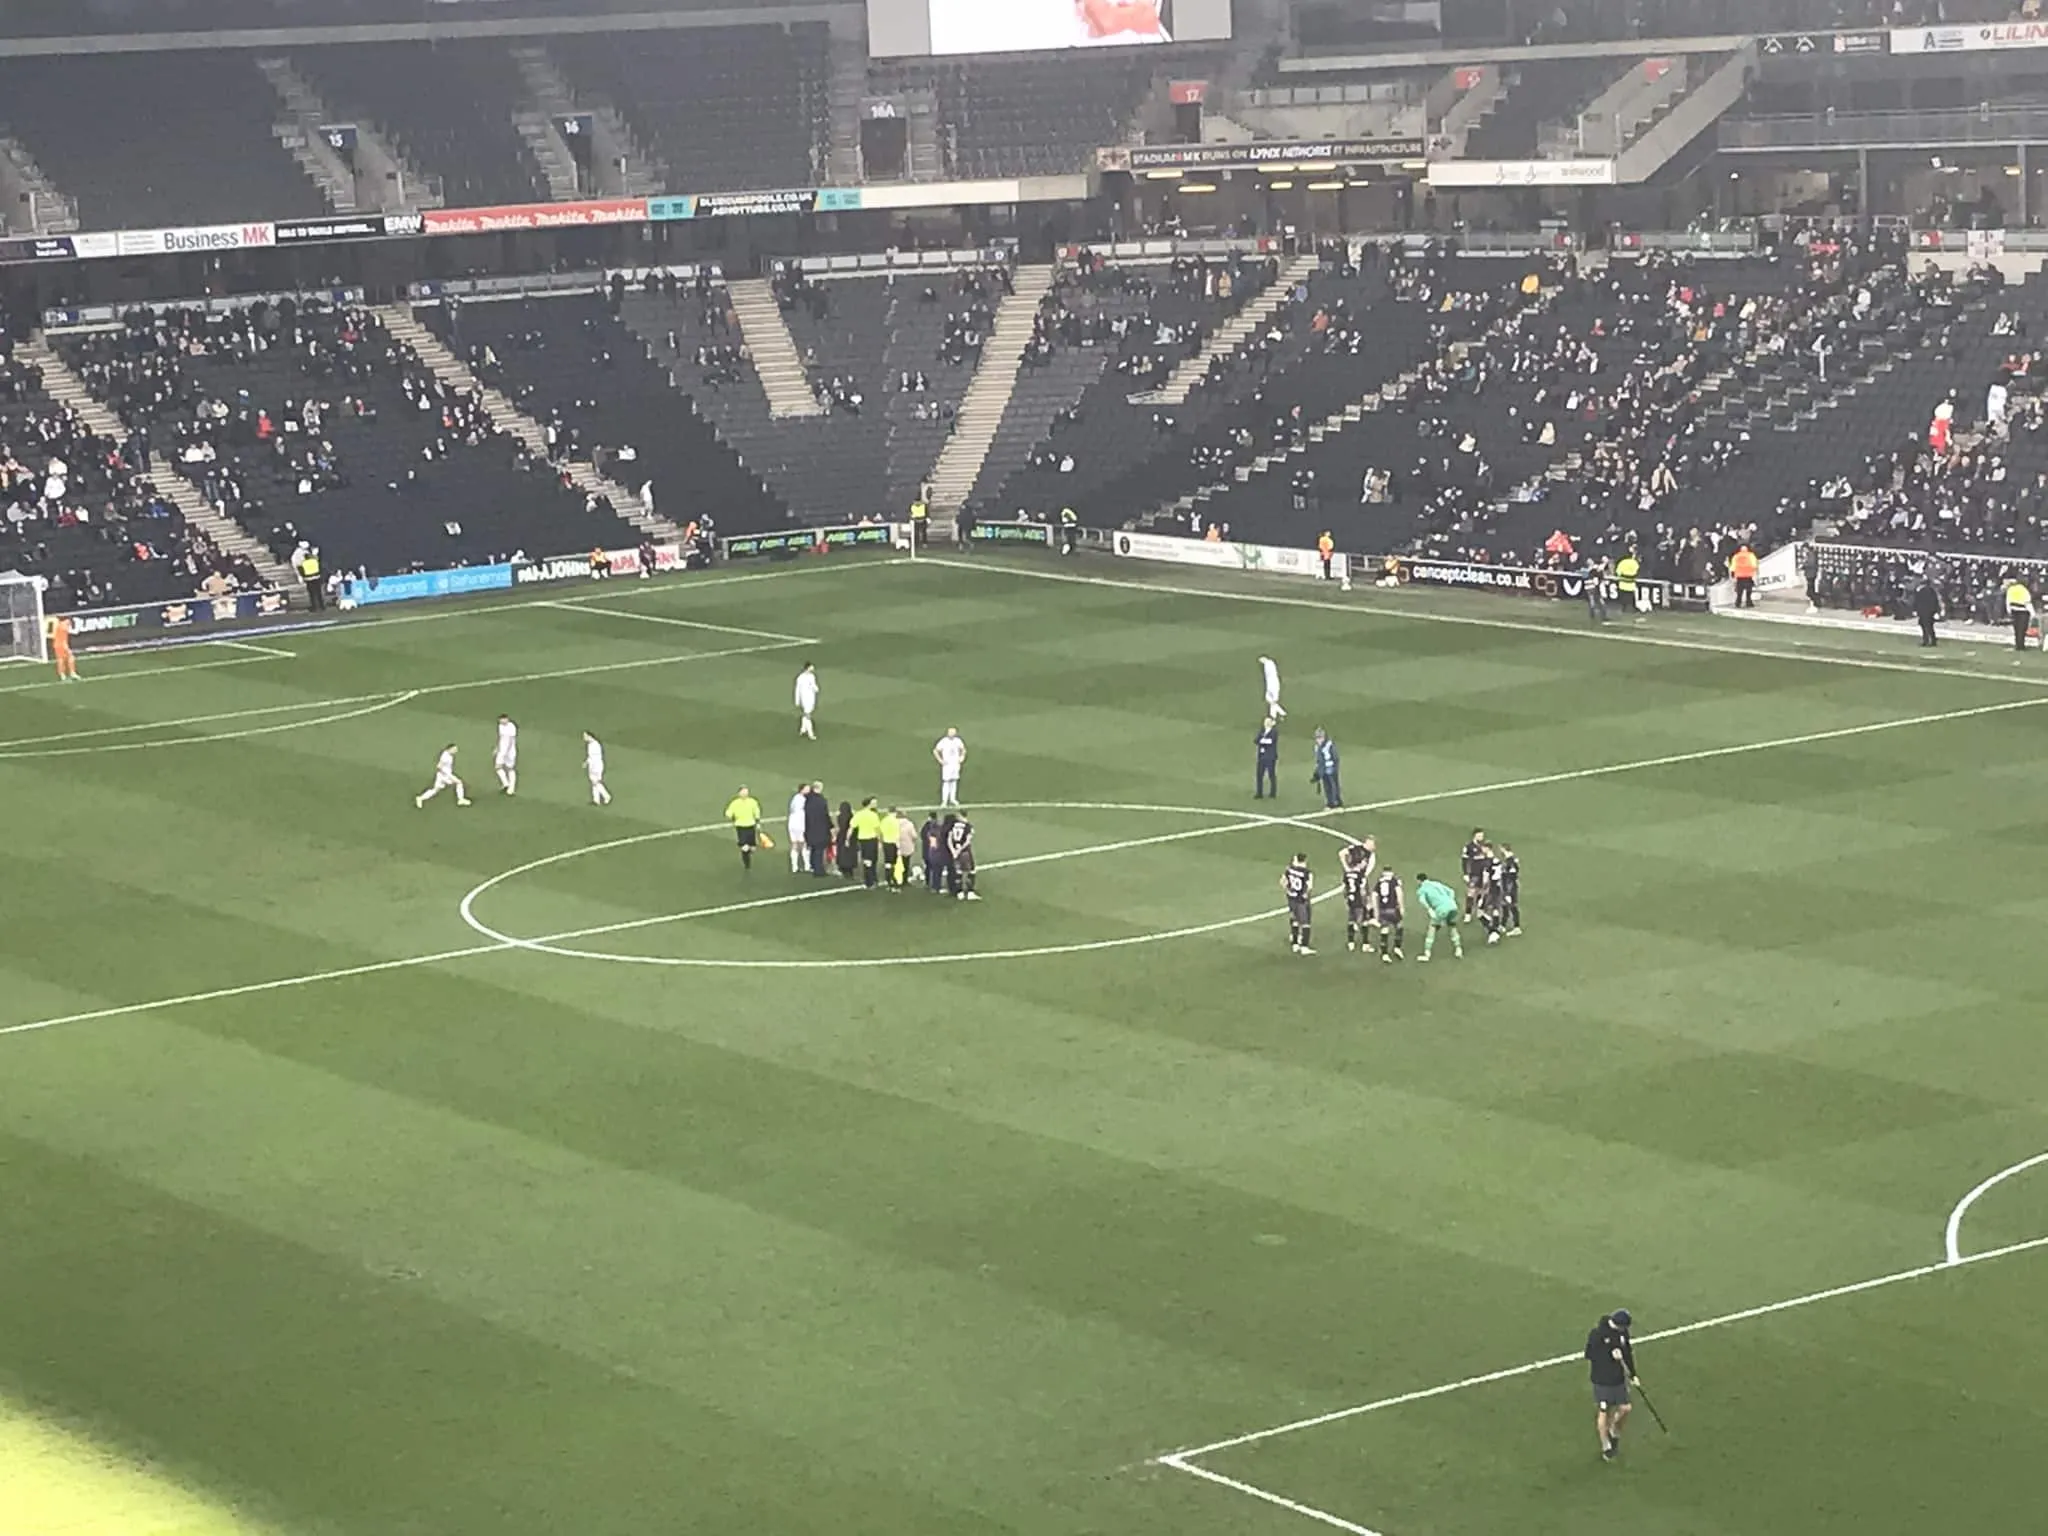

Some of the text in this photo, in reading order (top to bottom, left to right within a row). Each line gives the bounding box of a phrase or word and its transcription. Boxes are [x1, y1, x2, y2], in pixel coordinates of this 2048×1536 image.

[329, 134, 343, 147] 15
[1250, 147, 1281, 160] LYNX
[163, 228, 239, 250] Business
[242, 225, 270, 245] MK
[1412, 565, 1531, 589] conceptclean.co.uk
